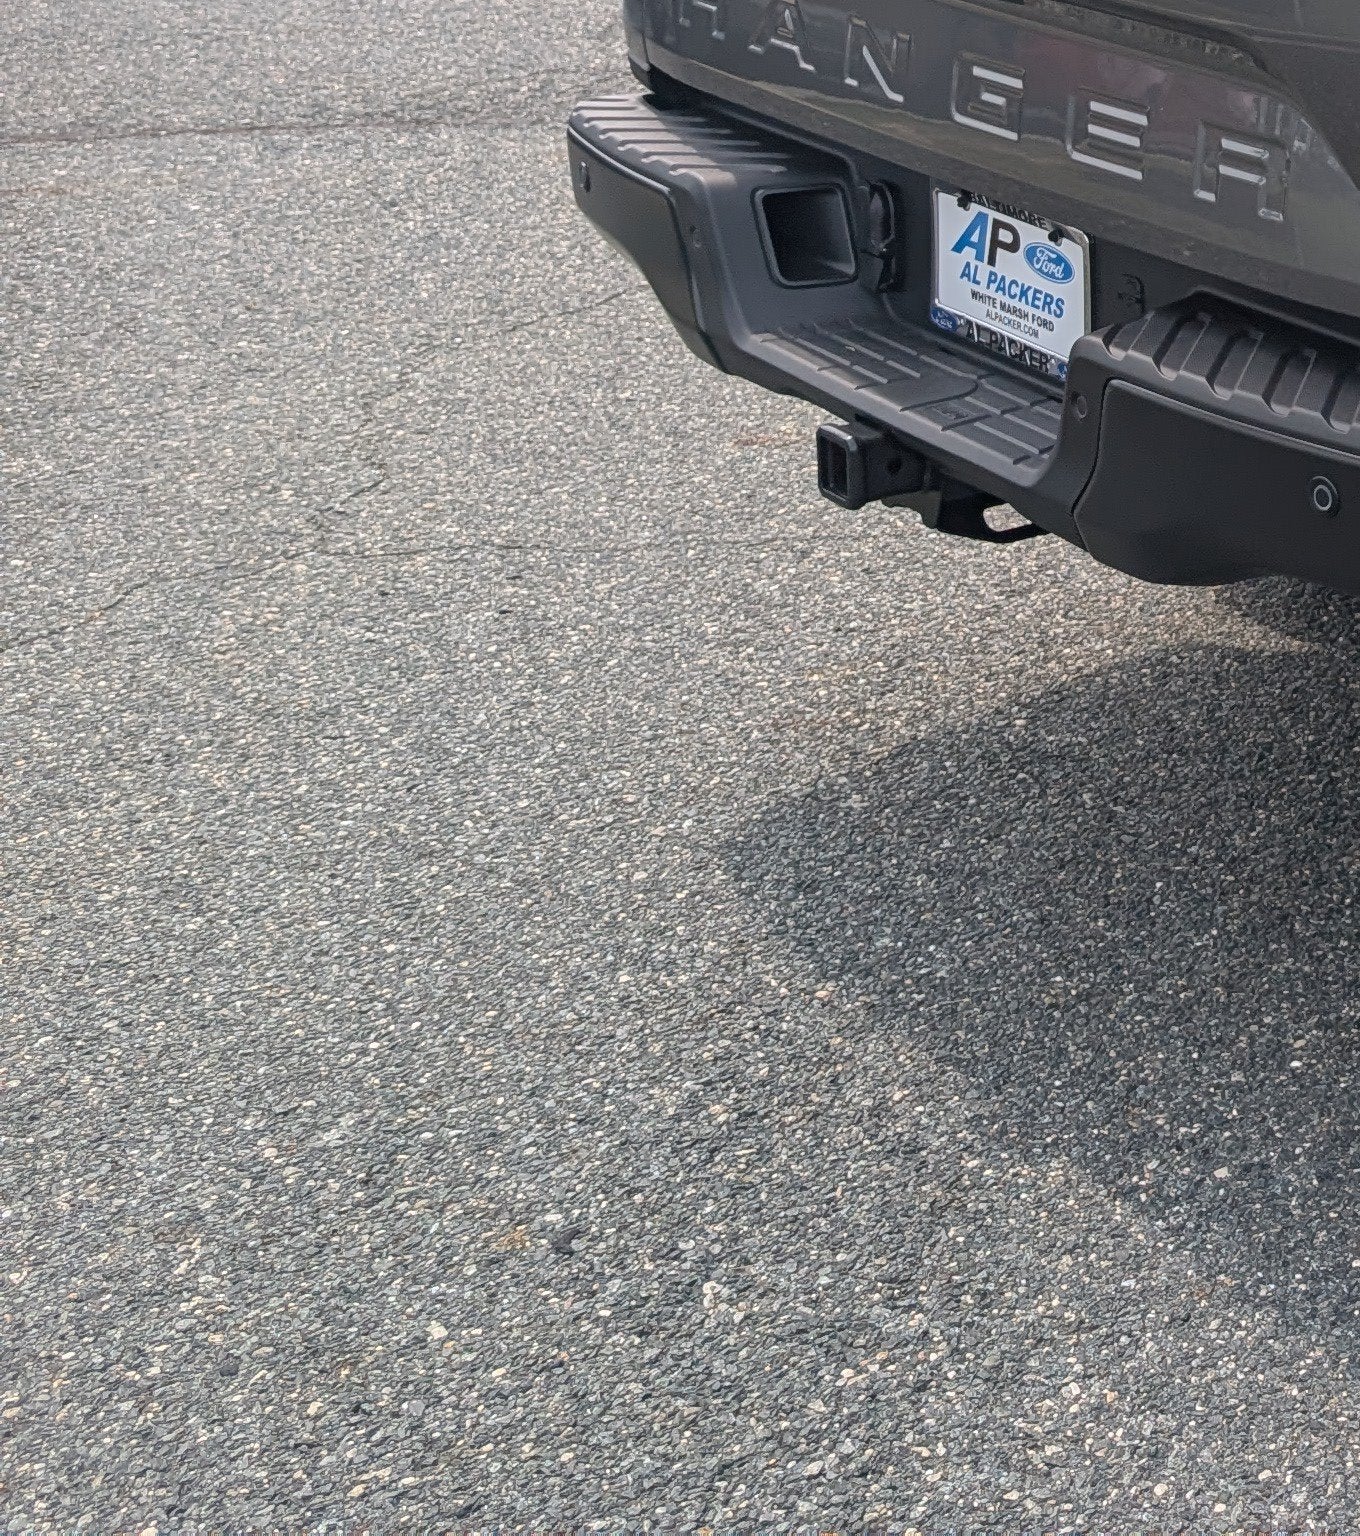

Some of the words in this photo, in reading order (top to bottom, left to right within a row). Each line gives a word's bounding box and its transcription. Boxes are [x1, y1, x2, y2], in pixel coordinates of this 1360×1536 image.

[969, 192, 1048, 230] BALTIMORE
[950, 210, 1021, 268] AP
[1033, 246, 1065, 279] Ford
[960, 261, 981, 286] AL
[986, 270, 1065, 319] PACKERS
[970, 288, 998, 308] WHITE
[999, 300, 1029, 321] MARSH
[1031, 313, 1055, 332] FORD
[985, 308, 1040, 339] ALPACKER.COM
[965, 319, 986, 343] AL
[988, 331, 1050, 374] PACKER
